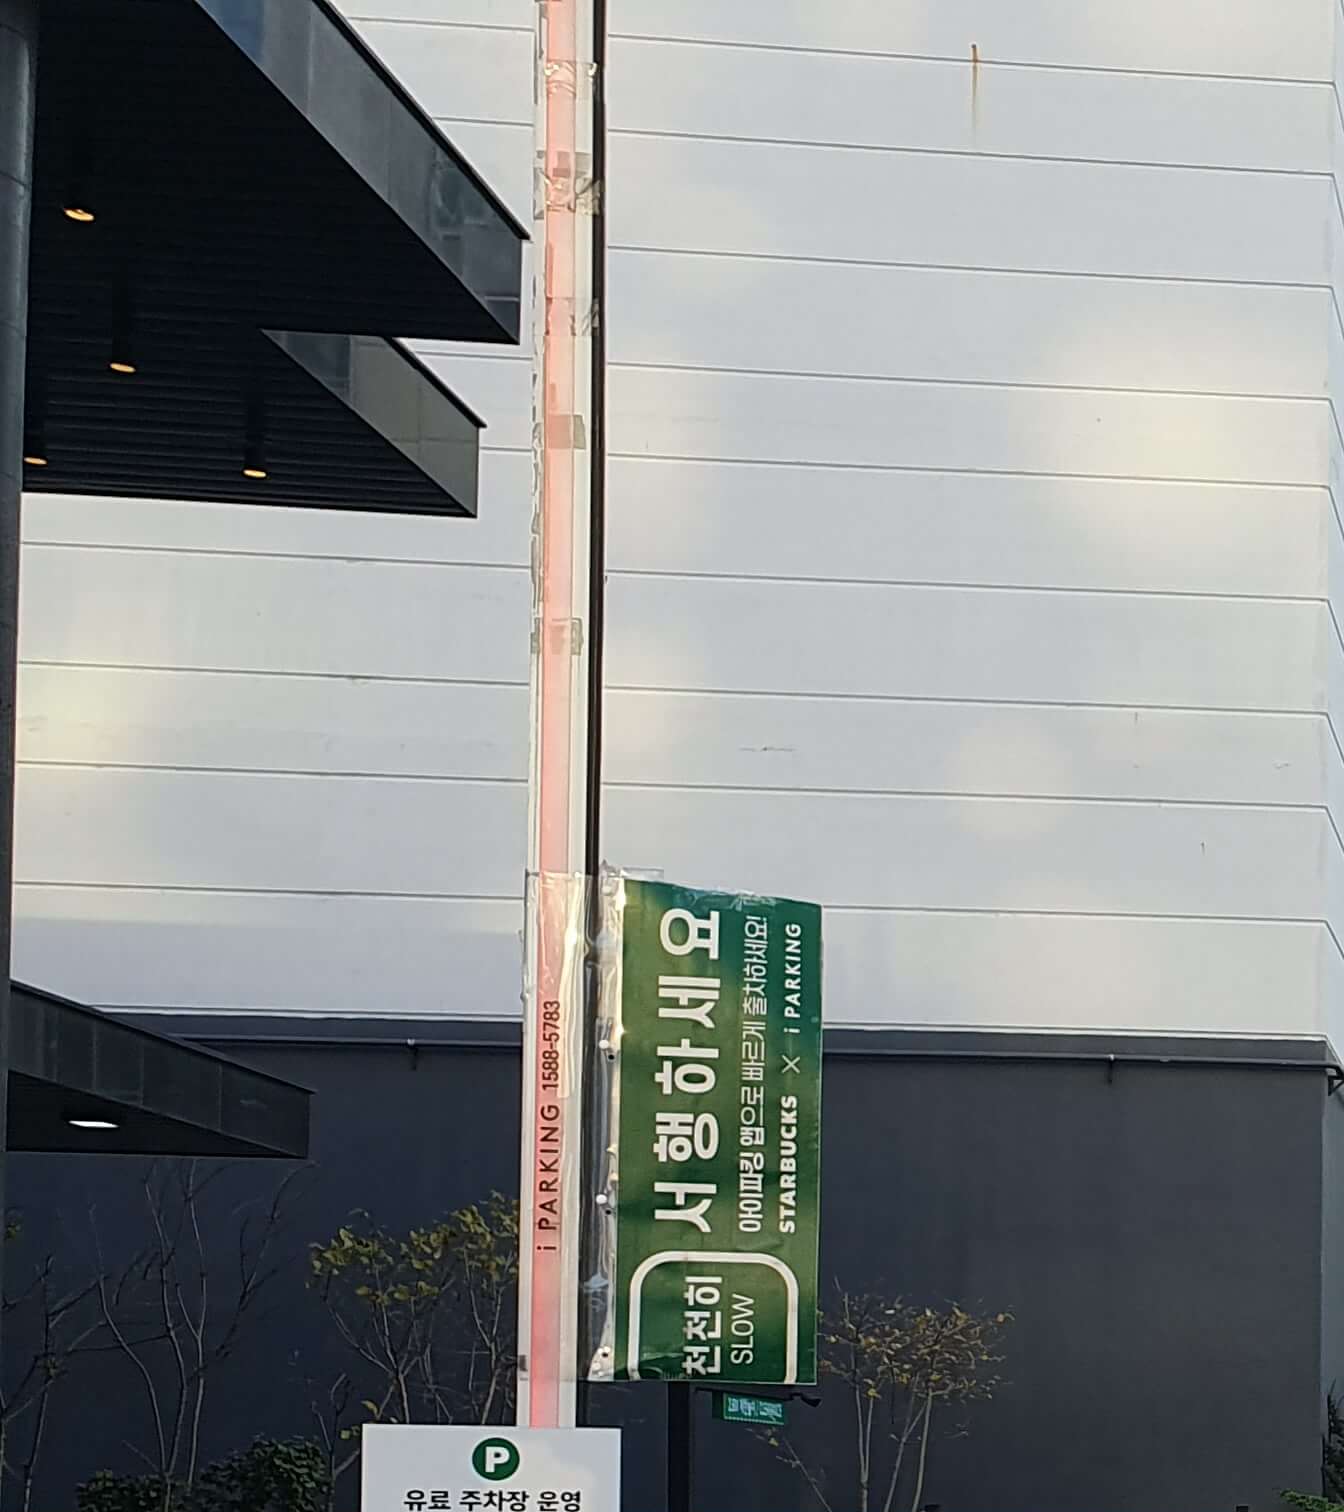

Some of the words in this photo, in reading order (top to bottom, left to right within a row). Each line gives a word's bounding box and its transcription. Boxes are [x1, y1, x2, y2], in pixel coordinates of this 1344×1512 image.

[742, 915, 768, 1016] 출차하세요!
[784, 923, 801, 1018] PARKING
[542, 1000, 560, 1091] 1588-5783
[654, 908, 720, 1233] 서행하세요
[741, 1021, 766, 1081] 빠르게
[740, 1086, 765, 1146] 앱으로
[538, 1105, 560, 1230] PARKING
[739, 1152, 765, 1232] 아이파킹
[779, 1095, 798, 1233] STARBUCKS
[682, 1276, 722, 1376] 천천히
[731, 1293, 755, 1365] SLOW
[404, 1490, 451, 1511] 유료
[459, 1490, 529, 1511] 주차장
[537, 1491, 581, 1512] 운영
